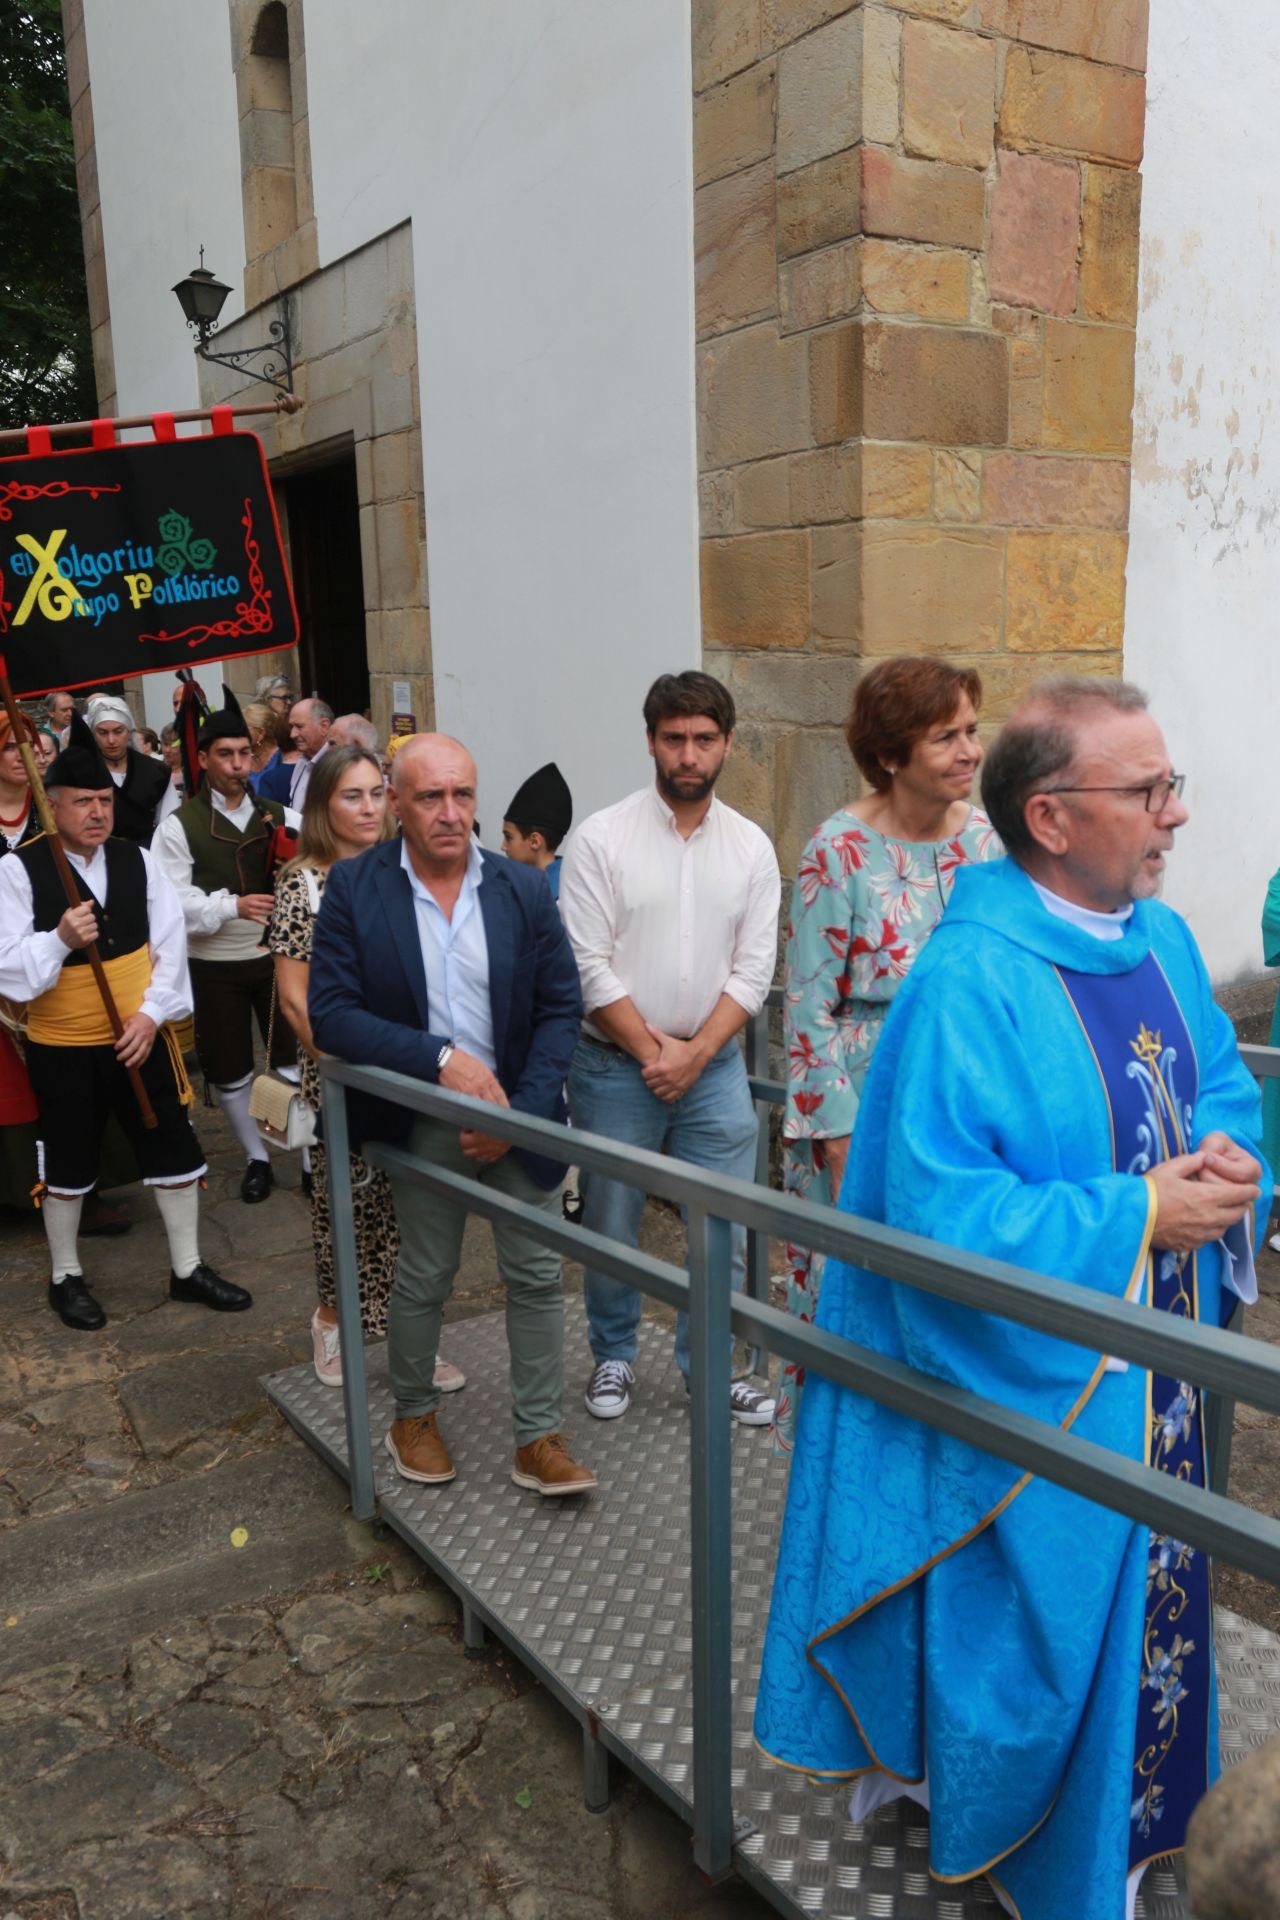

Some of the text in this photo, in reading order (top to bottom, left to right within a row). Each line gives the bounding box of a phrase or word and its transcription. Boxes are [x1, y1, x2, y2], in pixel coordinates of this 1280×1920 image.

[9, 529, 154, 626] El Xolgoriu
[38, 579, 119, 626] Grupo
